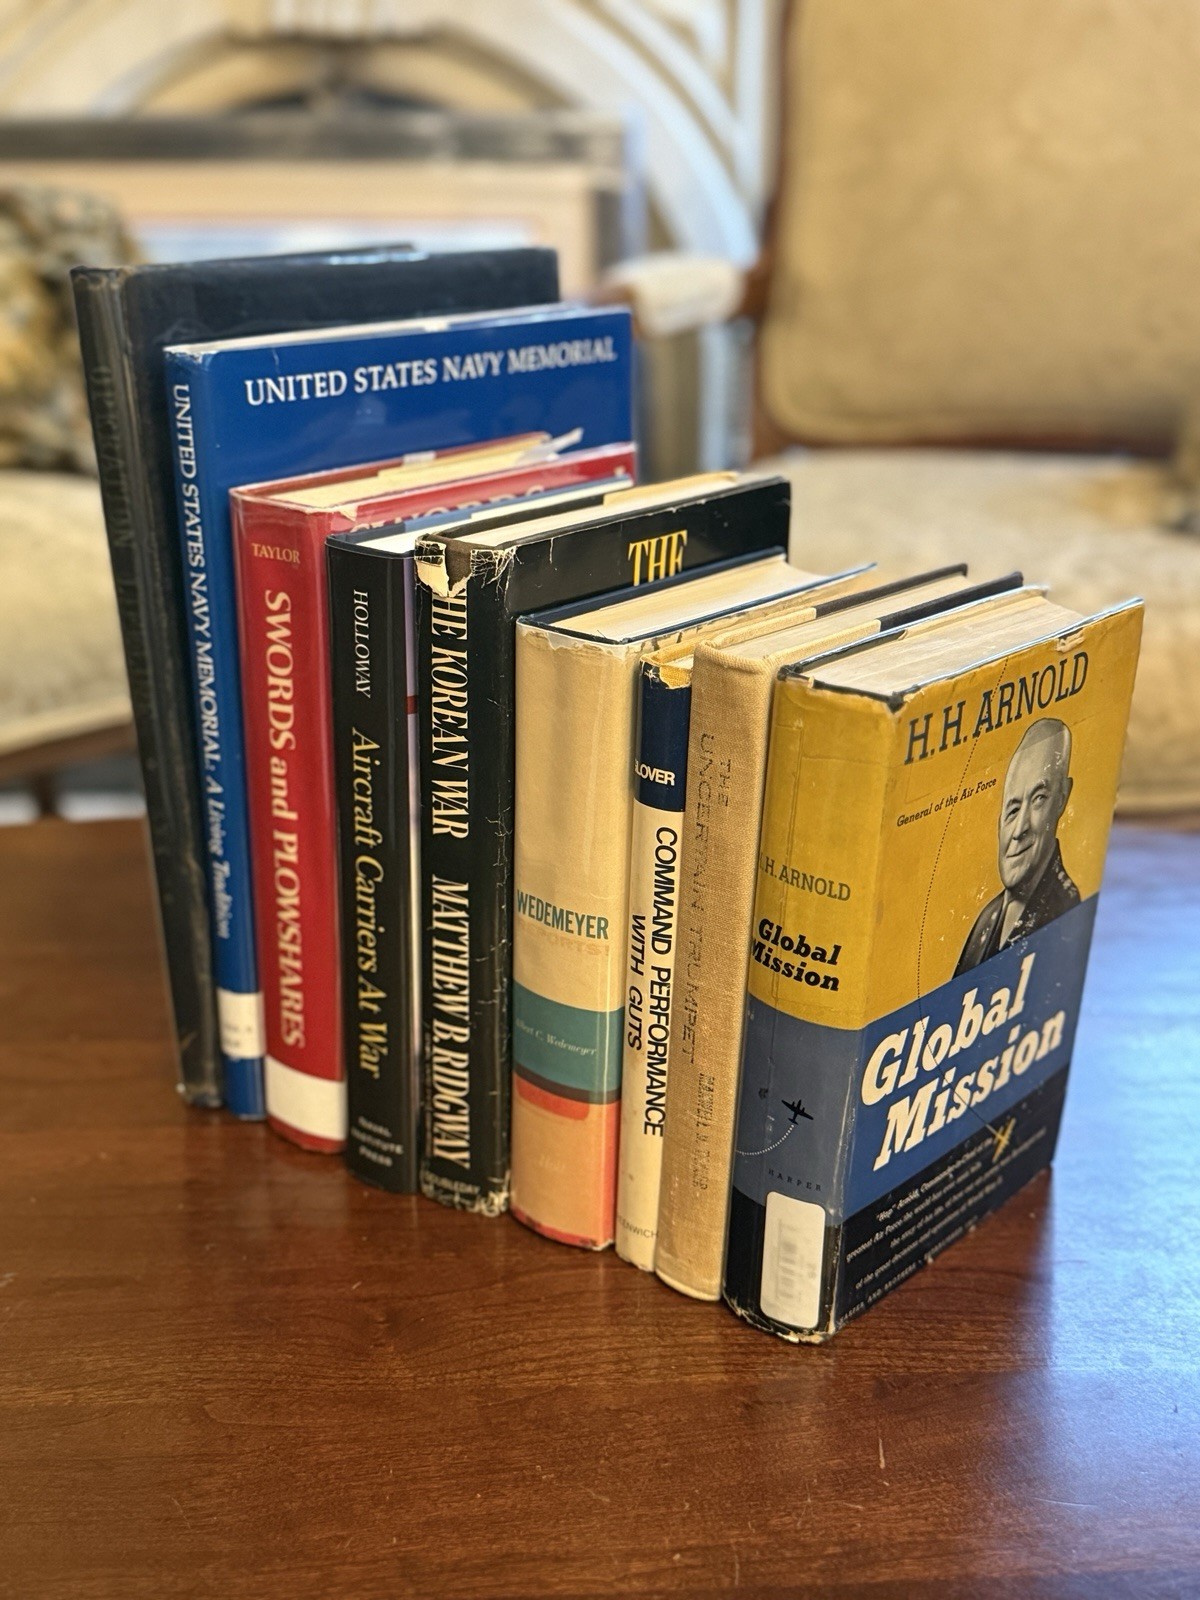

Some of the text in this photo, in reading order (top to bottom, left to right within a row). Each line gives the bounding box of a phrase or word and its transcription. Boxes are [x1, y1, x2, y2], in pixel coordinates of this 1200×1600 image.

[245, 336, 617, 406] UNITED STATES NAVY MEMORIAL
[173, 383, 197, 479] UNITED
[182, 482, 206, 569] STATES
[251, 542, 301, 564] TAYLOR
[190, 571, 212, 639] NAVY
[352, 589, 371, 699] HOLLOWAY
[431, 589, 470, 840] HE KOREAN WAR
[972, 651, 1089, 739] ARNOLD
[205, 775, 224, 794] A
[634, 759, 676, 788] LOVER
[896, 777, 997, 828] General of the Air Force
[264, 589, 306, 1049] SWORDS and PLOWSHARES
[352, 727, 389, 1080] Aircraft Carriers At War
[516, 889, 609, 940] WEDEMEYER
[779, 864, 851, 902] ARNOLD
[627, 914, 646, 1051] WITH GUTS
[643, 826, 678, 1138] COMMAND PERFORMANCE
[752, 939, 840, 992] Mission
[758, 918, 842, 966] Global
[432, 874, 471, 1170] MATTHEW B. RIDGWAY
[861, 952, 1036, 1106] Global
[872, 1010, 1066, 1172] Mission
[768, 1168, 822, 1192] HARPER
